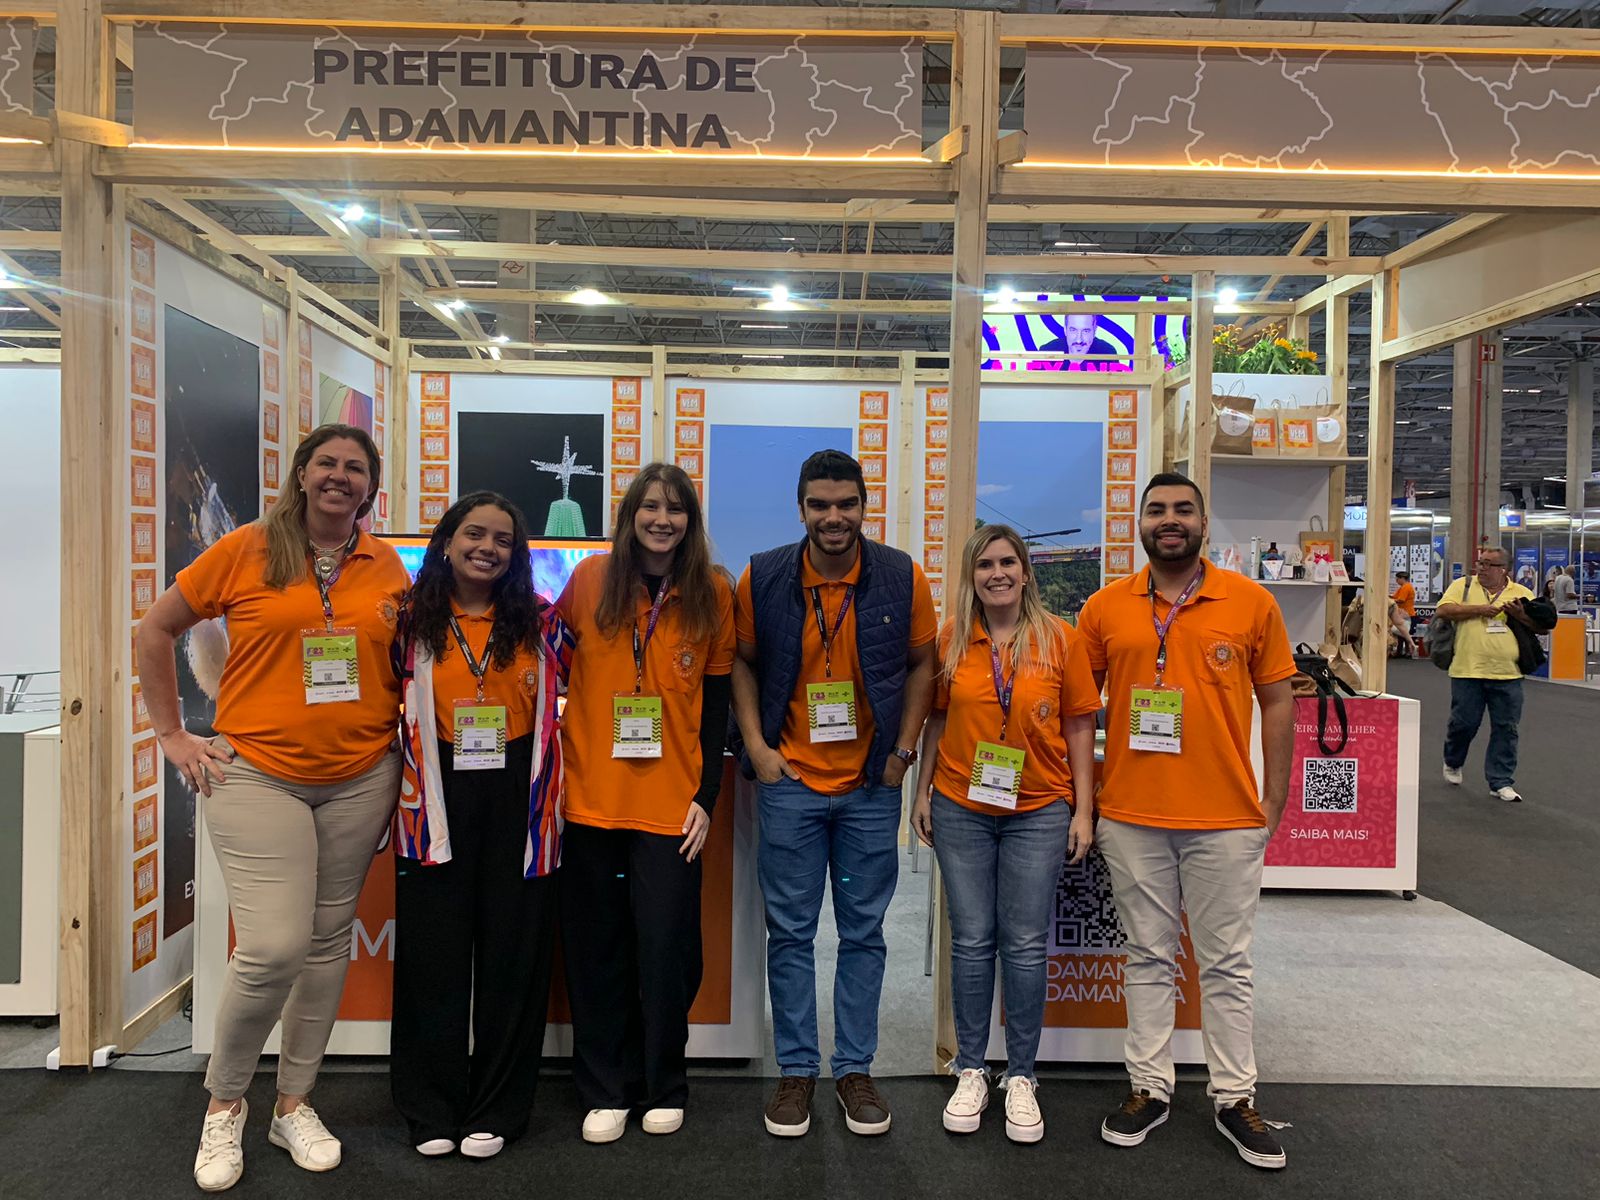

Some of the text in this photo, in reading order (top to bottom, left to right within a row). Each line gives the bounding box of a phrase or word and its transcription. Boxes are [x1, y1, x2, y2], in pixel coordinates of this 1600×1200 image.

[313, 49, 757, 92] PREFEITURA DE
[334, 107, 732, 149] ADAMANTINA
[1114, 399, 1131, 410] VEM
[1114, 431, 1131, 442] VEM
[1113, 462, 1130, 473] VEM
[1112, 493, 1129, 504] VEM
[1111, 524, 1128, 535] VEM
[1110, 555, 1128, 566] VEM
[1290, 829, 1369, 841] SAIBA MAIS!
